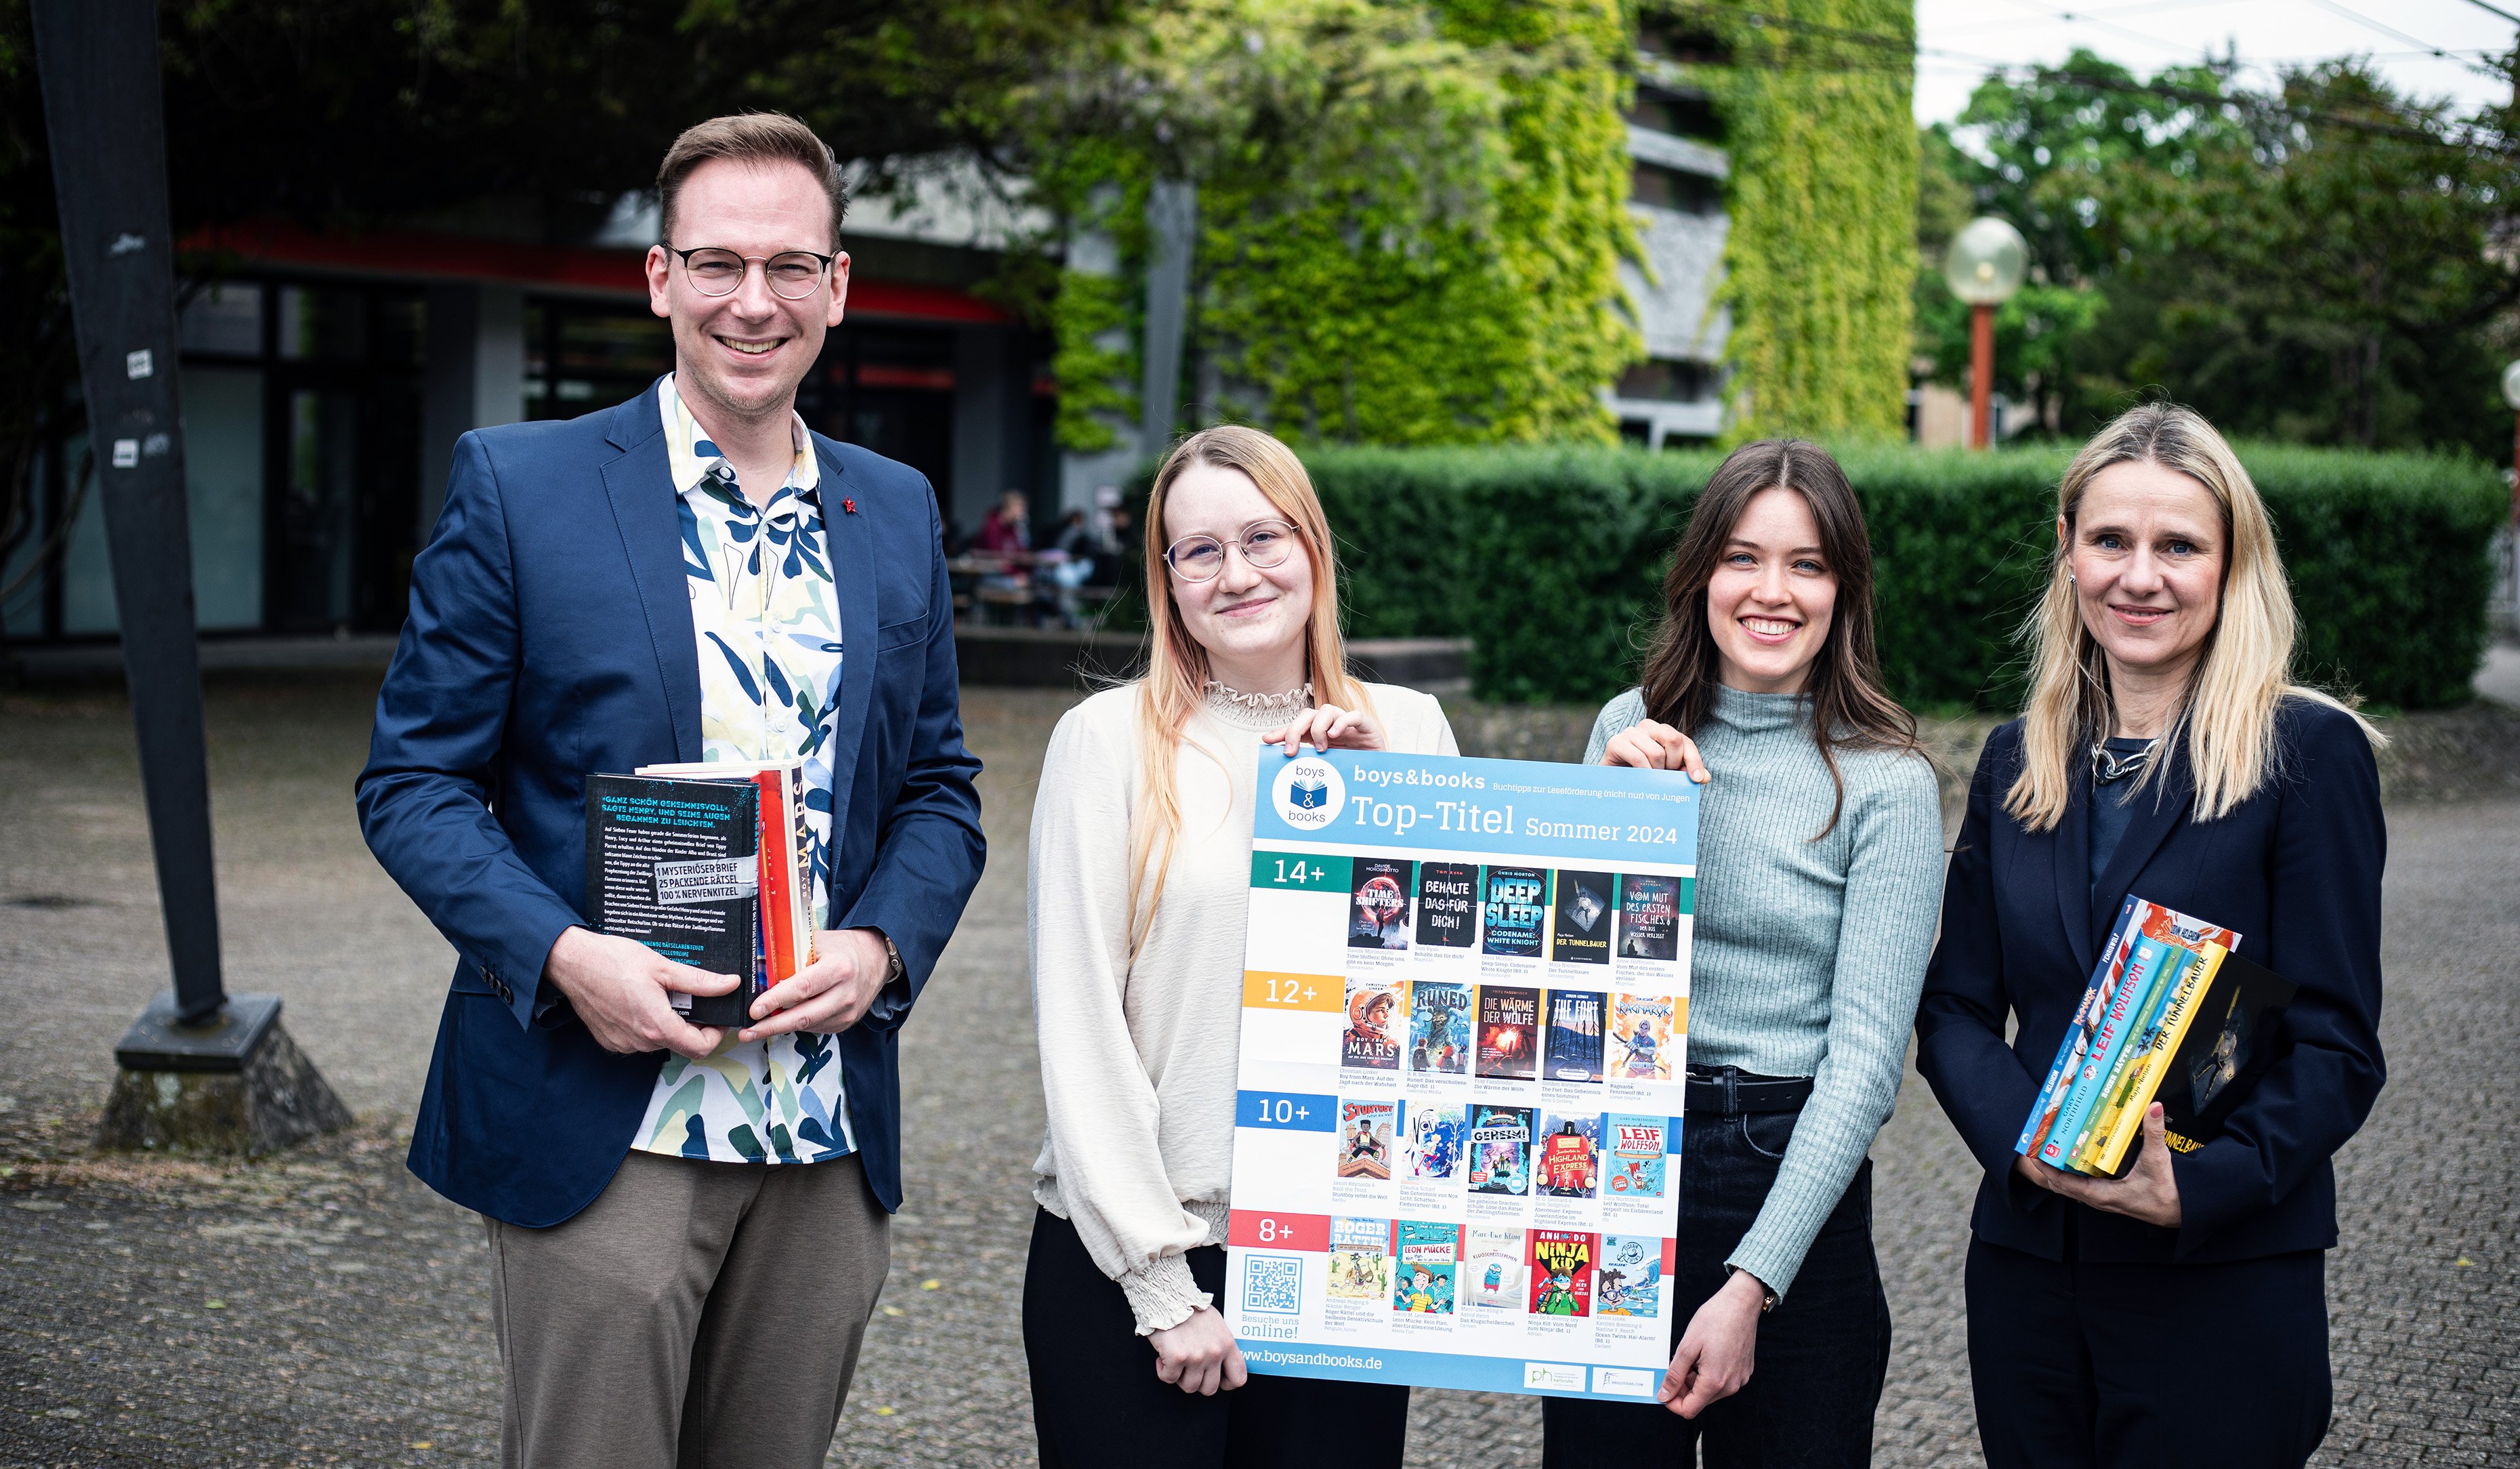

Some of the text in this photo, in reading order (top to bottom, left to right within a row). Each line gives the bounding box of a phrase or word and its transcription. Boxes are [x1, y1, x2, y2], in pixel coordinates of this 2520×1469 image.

[1297, 766, 1324, 779] boys
[1353, 764, 1690, 804] boys&books Buchtipps zur Leseförderung (nicht nur) von Jungen
[629, 798, 658, 806] SCHÖN
[1303, 793, 1314, 808] &
[616, 814, 659, 824] BEGANNEN
[673, 818, 715, 828] LEUCHTEN.
[629, 807, 656, 815] HENRY,
[677, 810, 700, 819] SEINE
[702, 812, 730, 821] AUGEN
[1288, 810, 1326, 823] books
[1351, 795, 1677, 845] Top-Titel Sommer 2024
[793, 779, 809, 868] MARS
[656, 863, 738, 876] 1 MYSTERIÖSER BRIEF
[1274, 858, 1325, 886] 14+
[659, 874, 738, 888] 25 PACKENDE RÄTSEL
[1426, 881, 1469, 894] BEHALTE
[660, 887, 738, 900] 100 % NERVENKITZEL
[1368, 889, 1393, 898] TIME
[1491, 877, 1541, 905] DEEP
[1630, 892, 1668, 903] VOM MUT
[1356, 896, 1404, 907] SHIFTERS
[1425, 898, 1468, 913] DAS FÜR
[1485, 903, 1544, 929] SLEEP
[2125, 905, 2132, 914] 1
[1491, 930, 1535, 938] CODENAME:
[2170, 925, 2181, 936] ODIN
[662, 941, 704, 951] RÄTSELABENTEUER
[1511, 938, 1539, 946] KNIGHT
[1569, 939, 1607, 948] TUNNELBAUER
[1265, 979, 1317, 1004] 12+
[1416, 989, 1468, 1011] RUNED
[1484, 997, 1534, 1012] DIE WÄRME
[2155, 957, 2208, 1051] DER TUNNELBAUER
[1555, 999, 1599, 1022] THE FORT
[1619, 1001, 1672, 1019] RAGNARÖK
[2091, 963, 2145, 1062] LEIF WOLFFSON
[1484, 1010, 1534, 1025] DER WÖLFE
[1347, 1041, 1395, 1057] MARS
[2101, 1074, 2117, 1099] ROGER
[2129, 1064, 2151, 1102] Maja Nielsen
[1259, 1098, 1309, 1123] 10+
[1343, 1102, 1393, 1122] STUNTBOY
[2061, 1085, 2088, 1135] NORTHFIELD
[2063, 1096, 2075, 1117] GARY
[1474, 1129, 1526, 1141] GEHEIM!
[1620, 1128, 1660, 1140] LEIF
[1620, 1140, 1660, 1151] WOLFFSON
[1549, 1154, 1588, 1164] HIGHLAND
[1553, 1162, 1587, 1174] EXPRESS
[1259, 1218, 1293, 1242] 8+
[1334, 1220, 1386, 1235] ROGER
[1473, 1230, 1521, 1241] Marc-Uwe Kling
[1540, 1231, 1586, 1242] ANH DO
[1424, 1245, 1451, 1254] MÜCKE
[1473, 1252, 1517, 1262] KLUGSCHEISSERCHEN
[1626, 1256, 1641, 1264] TWINS
[1242, 1315, 1284, 1324] Besuche
[1242, 1325, 1298, 1338] online!
[1240, 1350, 1383, 1370] ww.boysandbooks.de
